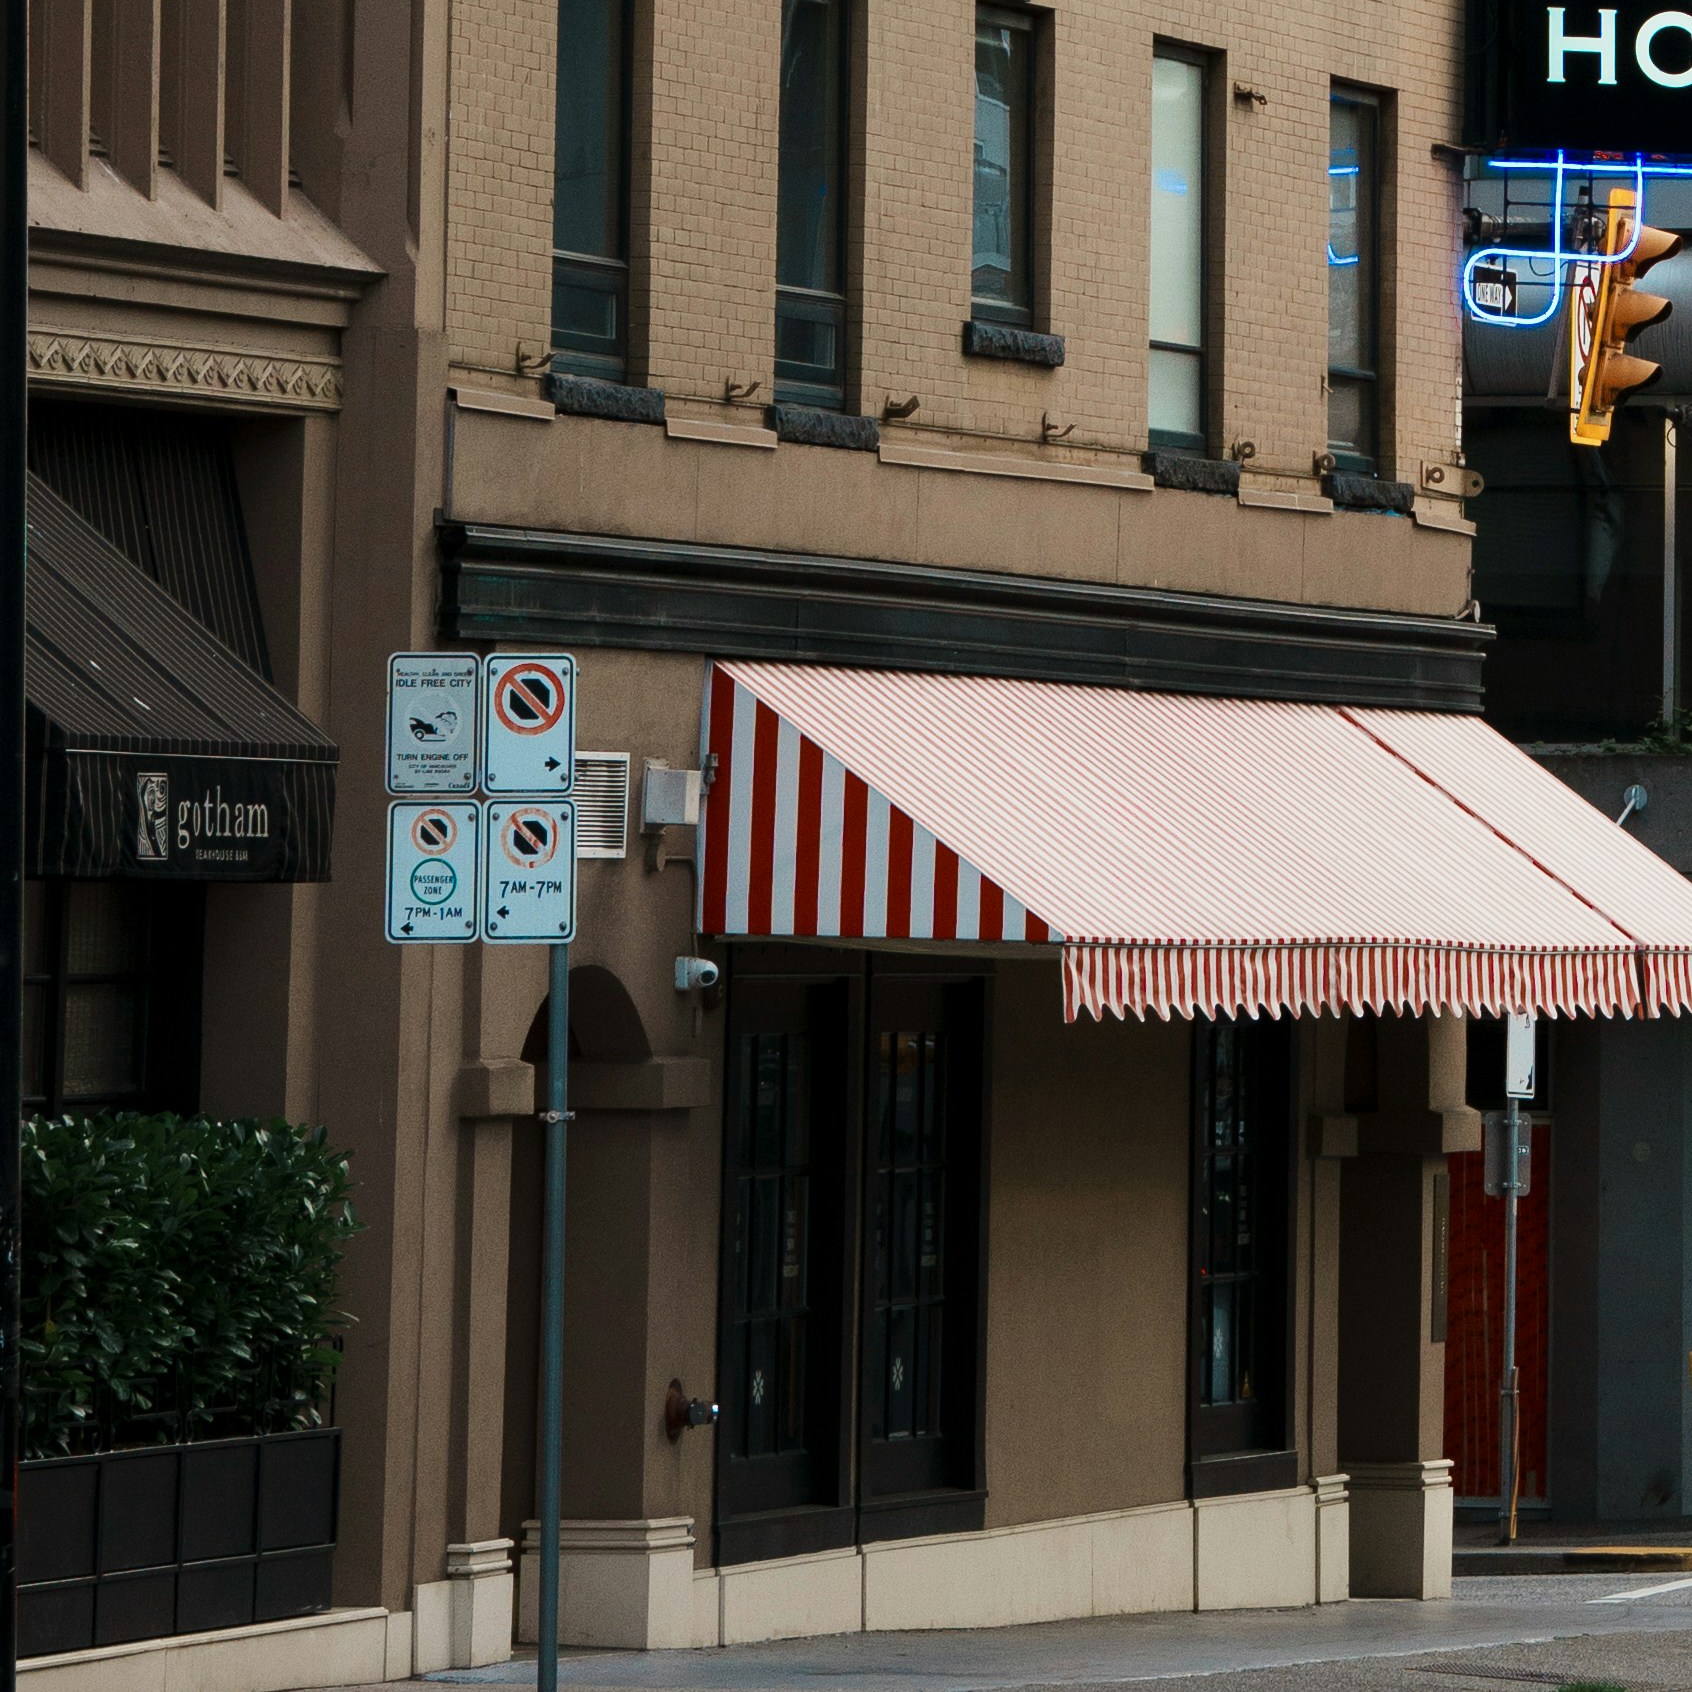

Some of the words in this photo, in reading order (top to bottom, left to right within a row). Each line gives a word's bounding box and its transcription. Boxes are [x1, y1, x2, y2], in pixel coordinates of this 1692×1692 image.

[395, 679, 417, 688] IDLE
[421, 679, 446, 688] FREE
[449, 679, 472, 688] CITY
[177, 784, 269, 849] gotham
[413, 875, 454, 884] PASSENGER
[423, 886, 442, 895] ZONE
